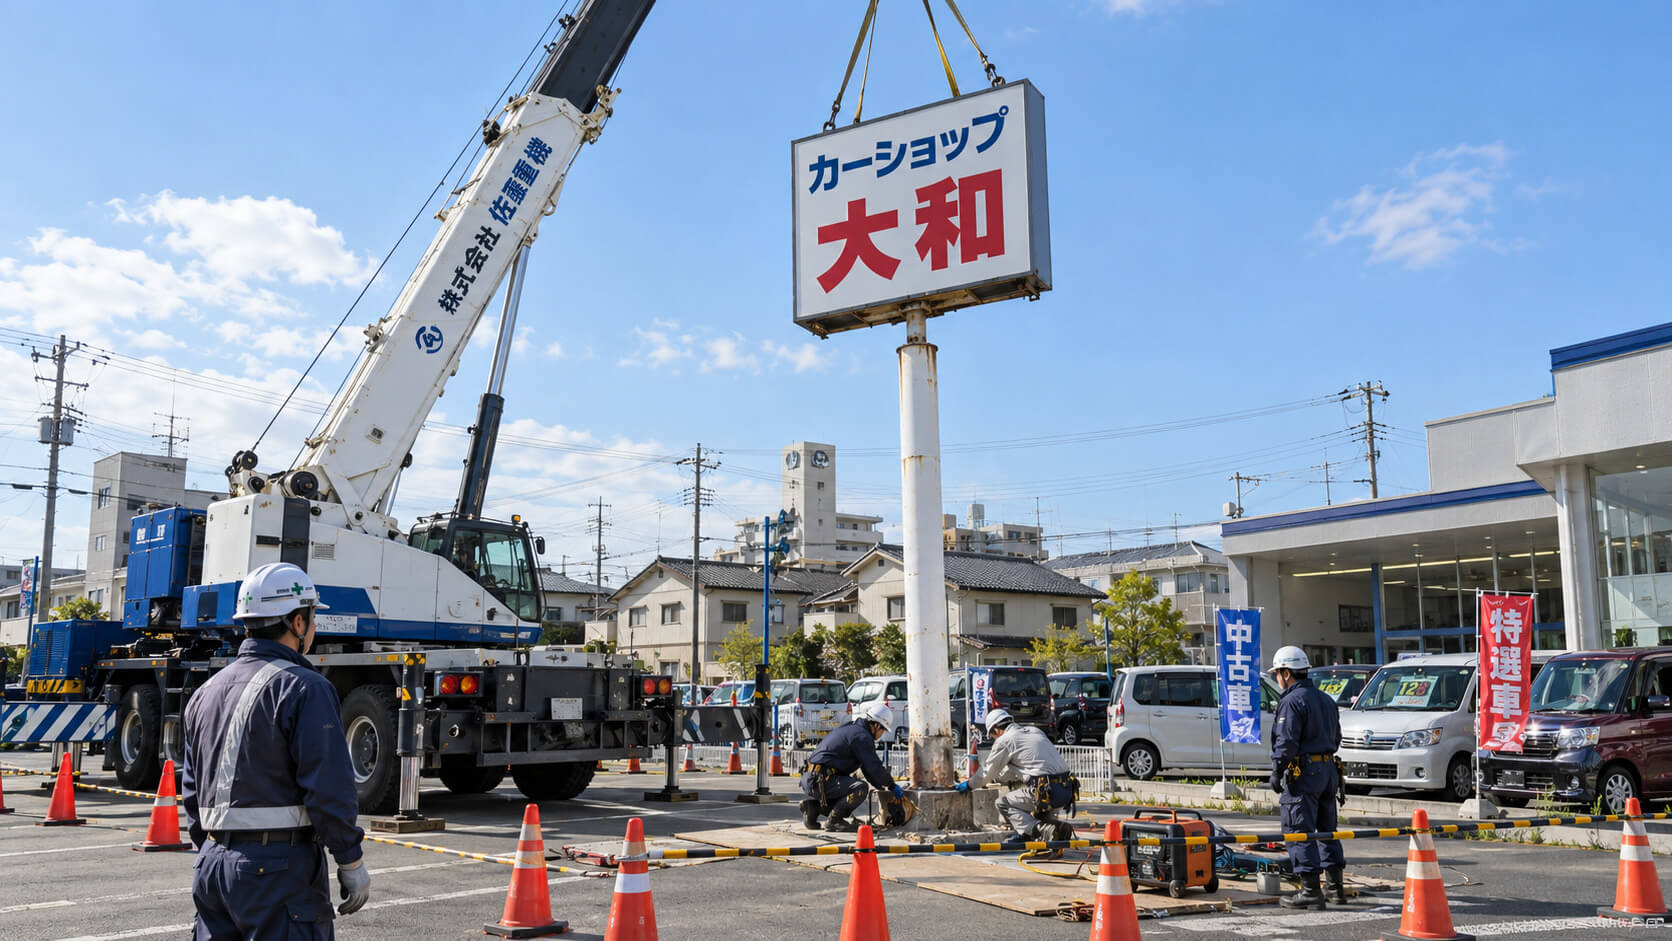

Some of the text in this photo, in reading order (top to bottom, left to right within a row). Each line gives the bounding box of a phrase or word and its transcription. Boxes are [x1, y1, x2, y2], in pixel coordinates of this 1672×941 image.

[809, 105, 1009, 194] カーショップ
[438, 225, 500, 315] 株式会社
[816, 168, 1005, 294] 大和
